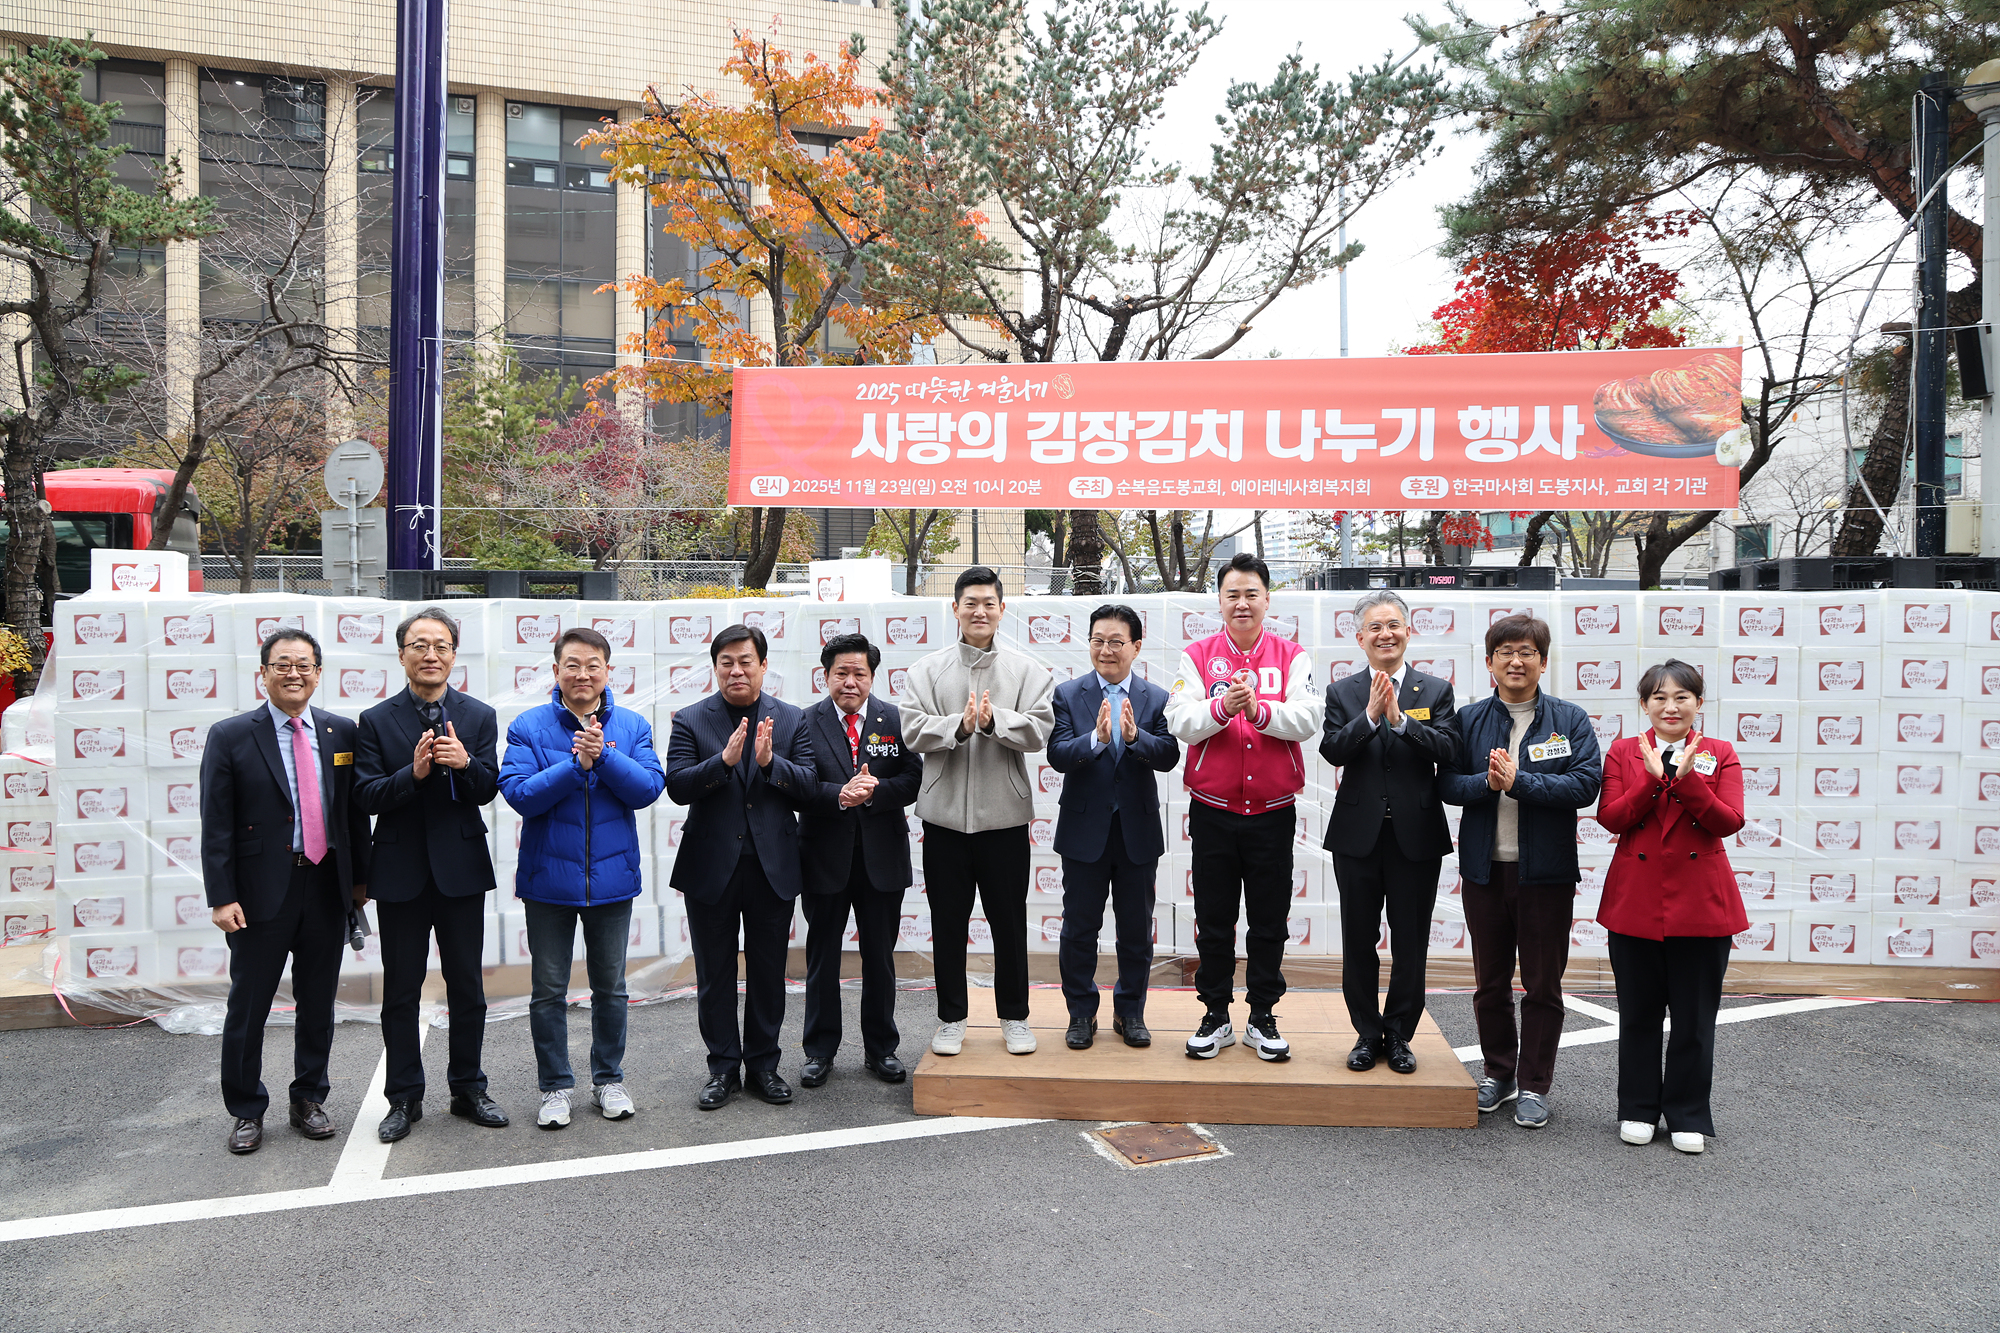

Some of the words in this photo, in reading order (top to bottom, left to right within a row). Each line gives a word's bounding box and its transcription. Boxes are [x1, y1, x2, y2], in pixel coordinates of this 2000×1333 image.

[856, 382, 901, 405] 2025
[905, 377, 974, 403] 따뜻한
[977, 375, 1048, 403] 겨울나기
[851, 411, 1008, 464] 사랑의
[1027, 409, 1244, 464] 김장김치
[1266, 408, 1435, 463] 나누기
[1458, 405, 1584, 462] 행사
[756, 478, 783, 494] 일시
[793, 479, 840, 494] 2025년
[846, 479, 875, 495] 11월
[880, 479, 936, 495] 23일(일)
[940, 479, 967, 495] 오전
[973, 479, 1004, 495] 10시
[1008, 479, 1042, 495] 20분
[1074, 478, 1105, 495] 주최
[1116, 479, 1226, 496] 순복음도봉교회,
[1231, 479, 1370, 496] 에이레네사회복지회
[1407, 478, 1440, 496] 후원
[1453, 478, 1533, 495] 한국마사회
[1538, 478, 1609, 496] 도봉지사,
[1615, 478, 1647, 495] 교회
[1653, 478, 1669, 495] 각
[1675, 477, 1708, 495] 기관
[1429, 575, 1455, 585] LOGISALL
[1259, 667, 1282, 694] D
[866, 744, 899, 757] 안병건
